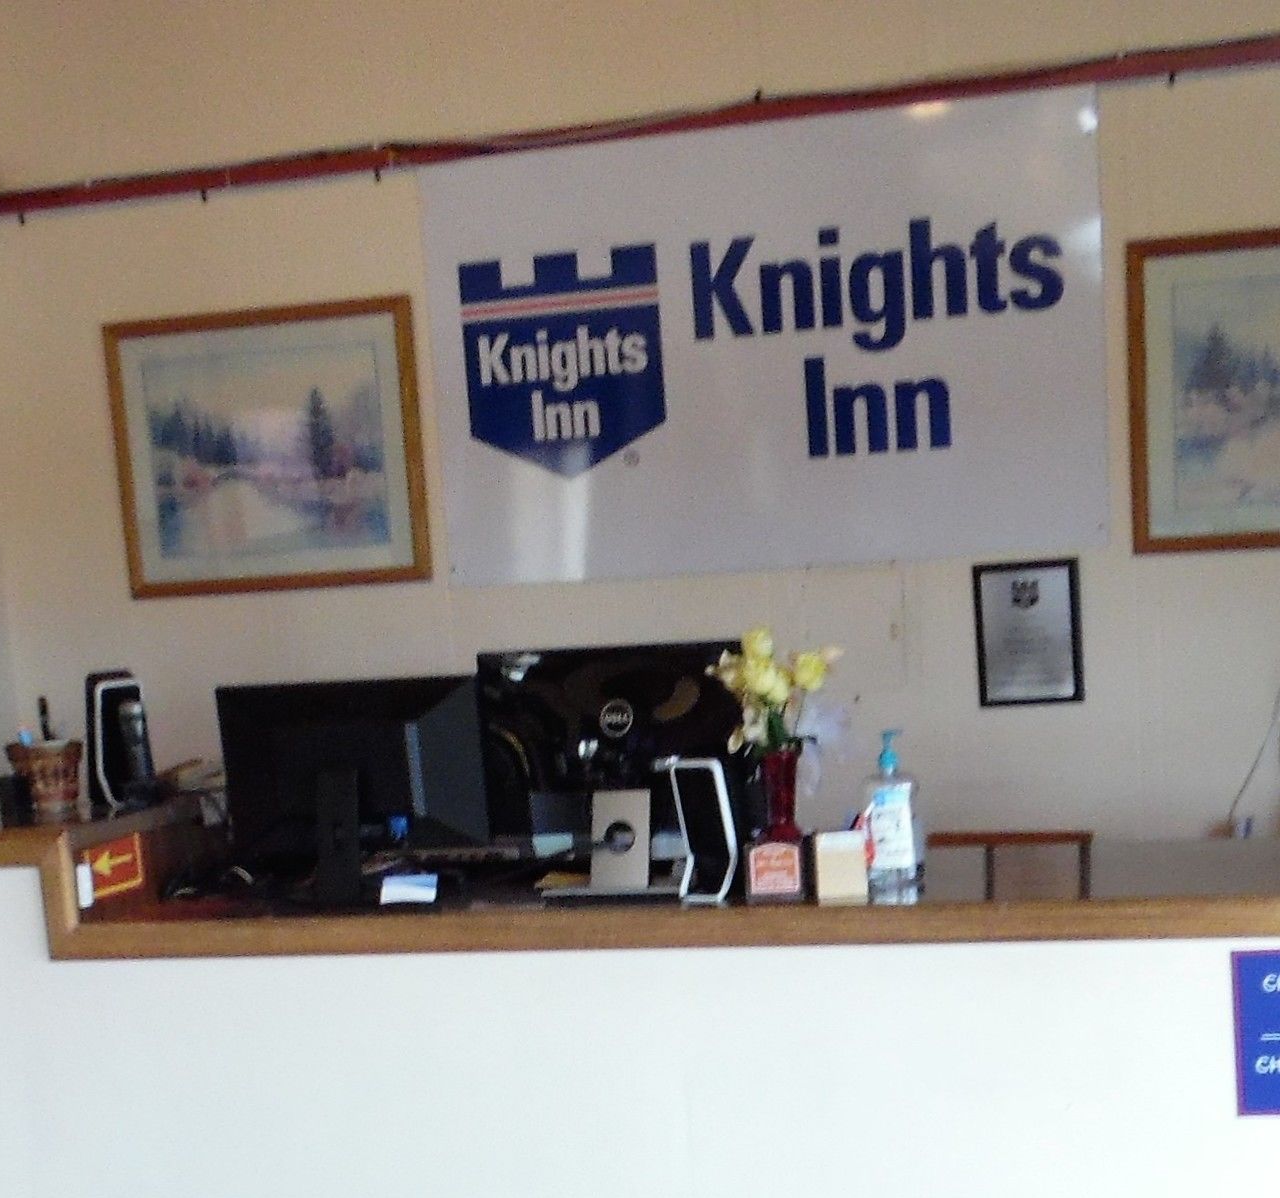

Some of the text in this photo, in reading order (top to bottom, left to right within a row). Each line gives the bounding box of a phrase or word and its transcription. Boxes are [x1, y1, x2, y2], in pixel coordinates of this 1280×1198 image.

[689, 218, 1065, 351] Knights
[477, 325, 649, 391] Knights
[531, 390, 601, 441] Inn
[804, 356, 953, 458] Inn
